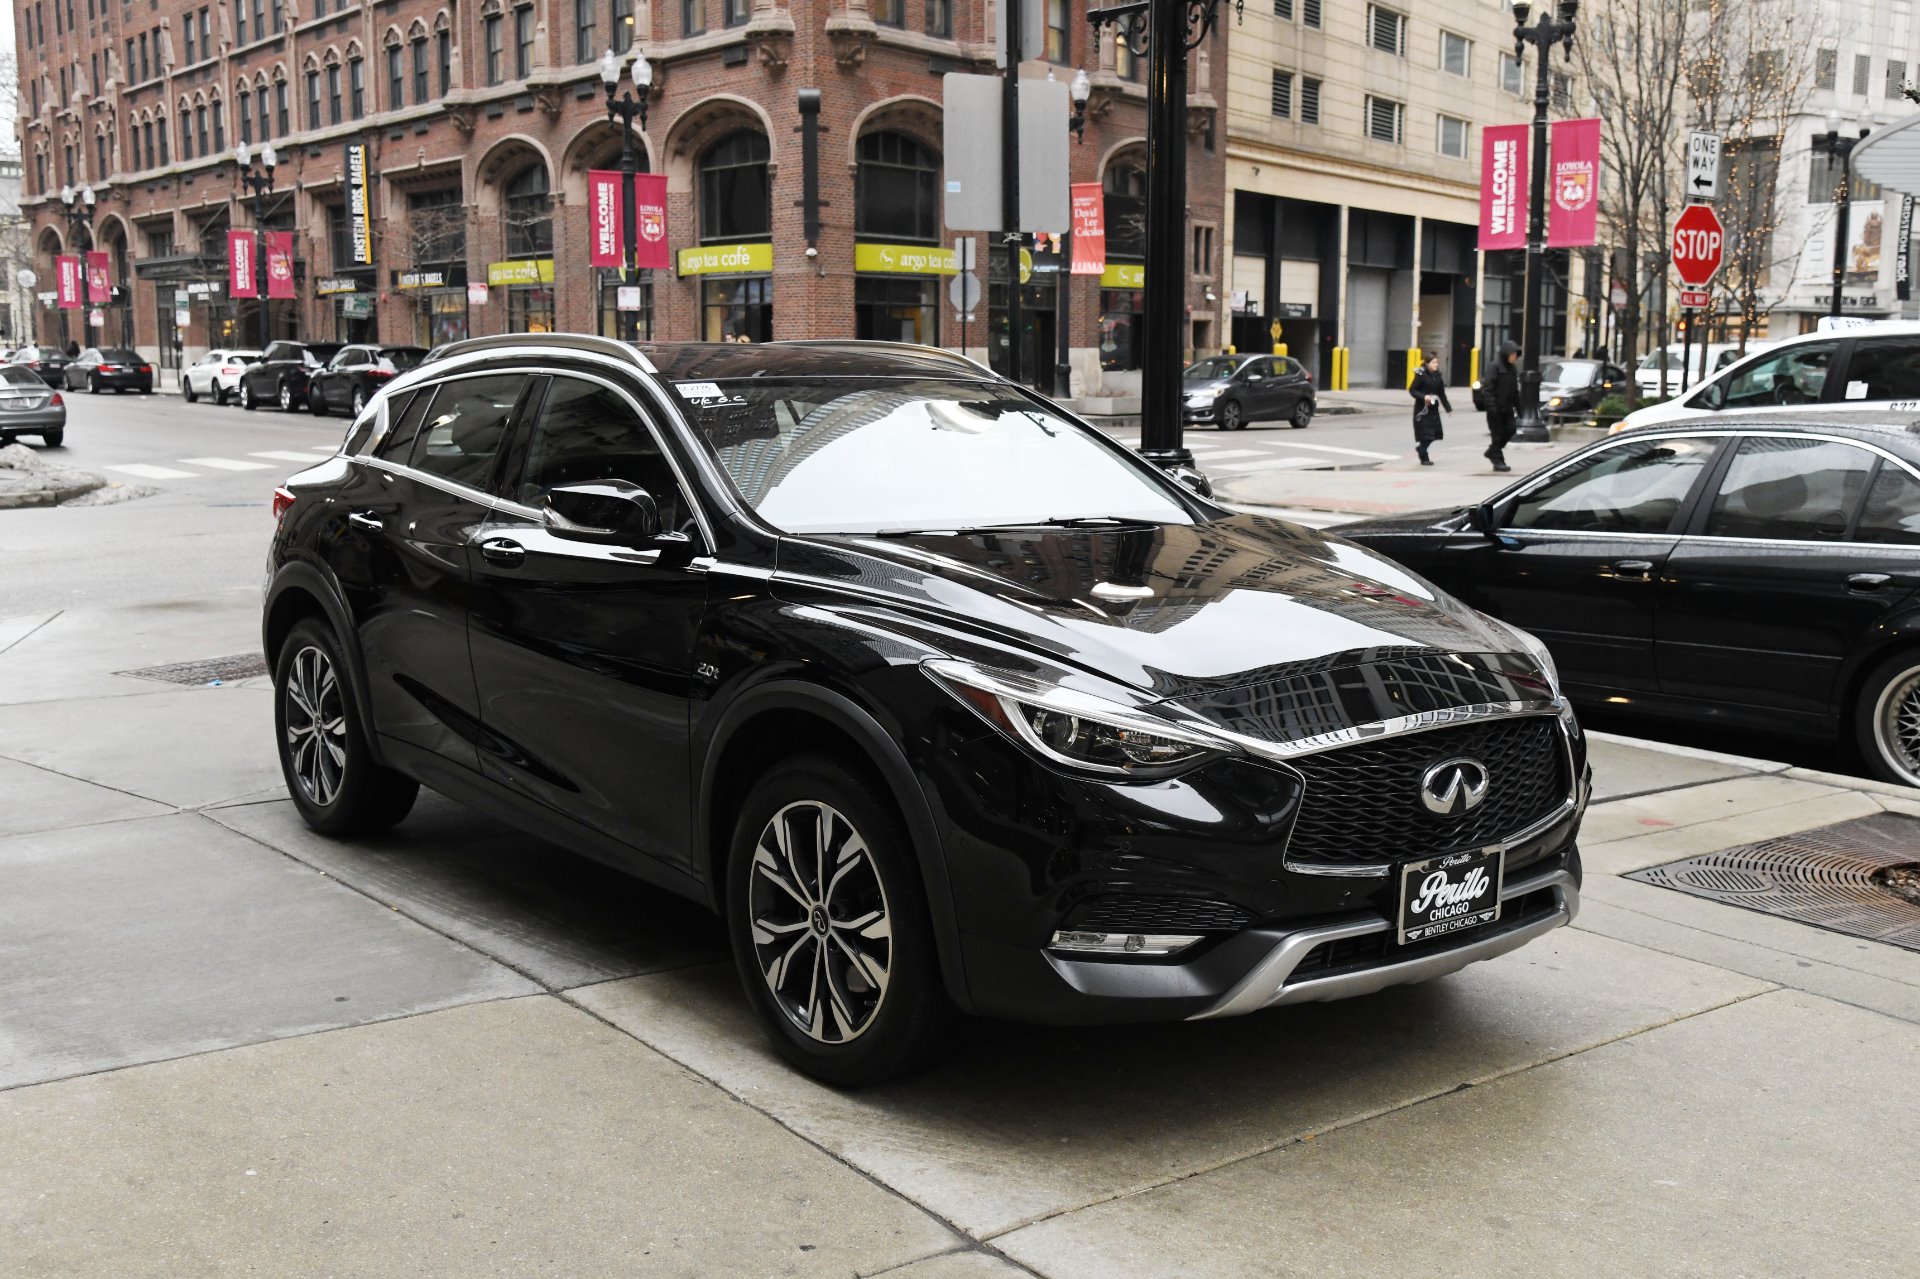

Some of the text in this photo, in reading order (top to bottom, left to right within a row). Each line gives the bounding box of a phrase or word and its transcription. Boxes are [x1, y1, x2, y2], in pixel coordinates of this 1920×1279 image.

[1693, 137, 1716, 154] ONE
[349, 145, 363, 185] BAGELS
[1557, 161, 1593, 172] LOYOLA
[1692, 155, 1716, 171] WAY
[1491, 140, 1508, 235] WELCOME
[1506, 140, 1517, 234] WATER TOWER CAMPUS
[598, 182, 610, 255] WELCOME
[640, 204, 664, 213] LOYOLA
[1075, 208, 1098, 218] David
[1084, 218, 1098, 227] Lee
[353, 216, 366, 262] EINSTEIN
[1675, 229, 1721, 261] STOP
[234, 239, 246, 290] WELCOME
[687, 245, 751, 272] argo tea café
[900, 255, 926, 271] argo
[928, 254, 942, 268] tea
[1070, 262, 1105, 274] LUMA
[1896, 254, 1909, 281] rack
[1682, 294, 1694, 305] ALL
[1439, 853, 1471, 869] Perillo
[1411, 866, 1490, 914] Perillo
[1429, 902, 1469, 921] CHICAGO
[1424, 915, 1478, 937] BENTLEY CHICAGO
